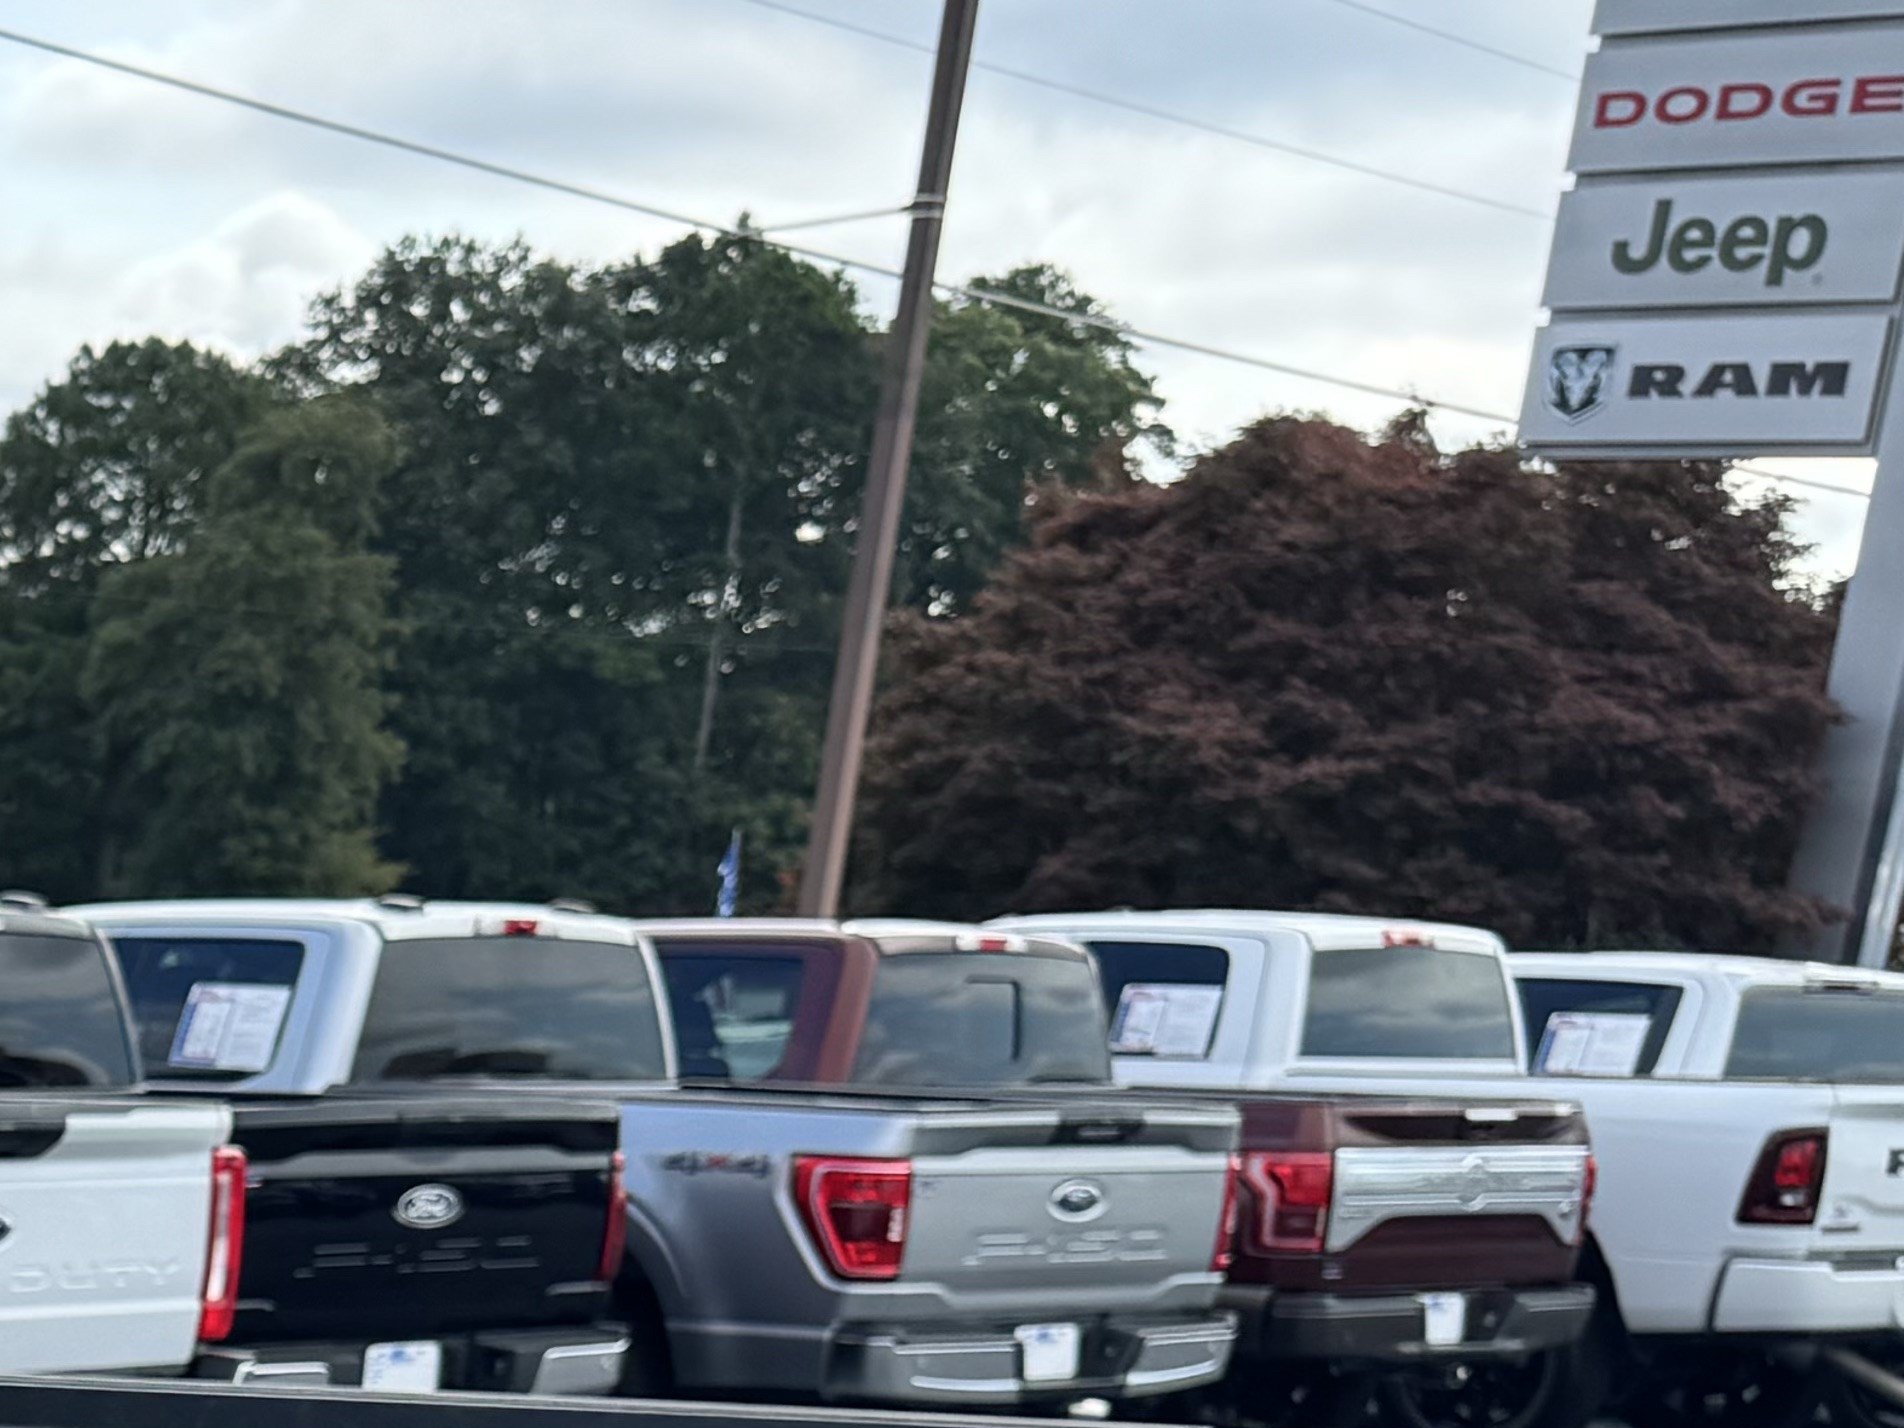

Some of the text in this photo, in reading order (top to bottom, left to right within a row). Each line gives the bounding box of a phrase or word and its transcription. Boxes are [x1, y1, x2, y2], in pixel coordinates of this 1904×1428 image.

[1594, 75, 1904, 129] DODGE
[1611, 199, 1828, 287] Jeep
[1627, 361, 1850, 398] RAM
[10, 1257, 180, 1293] DUTY
